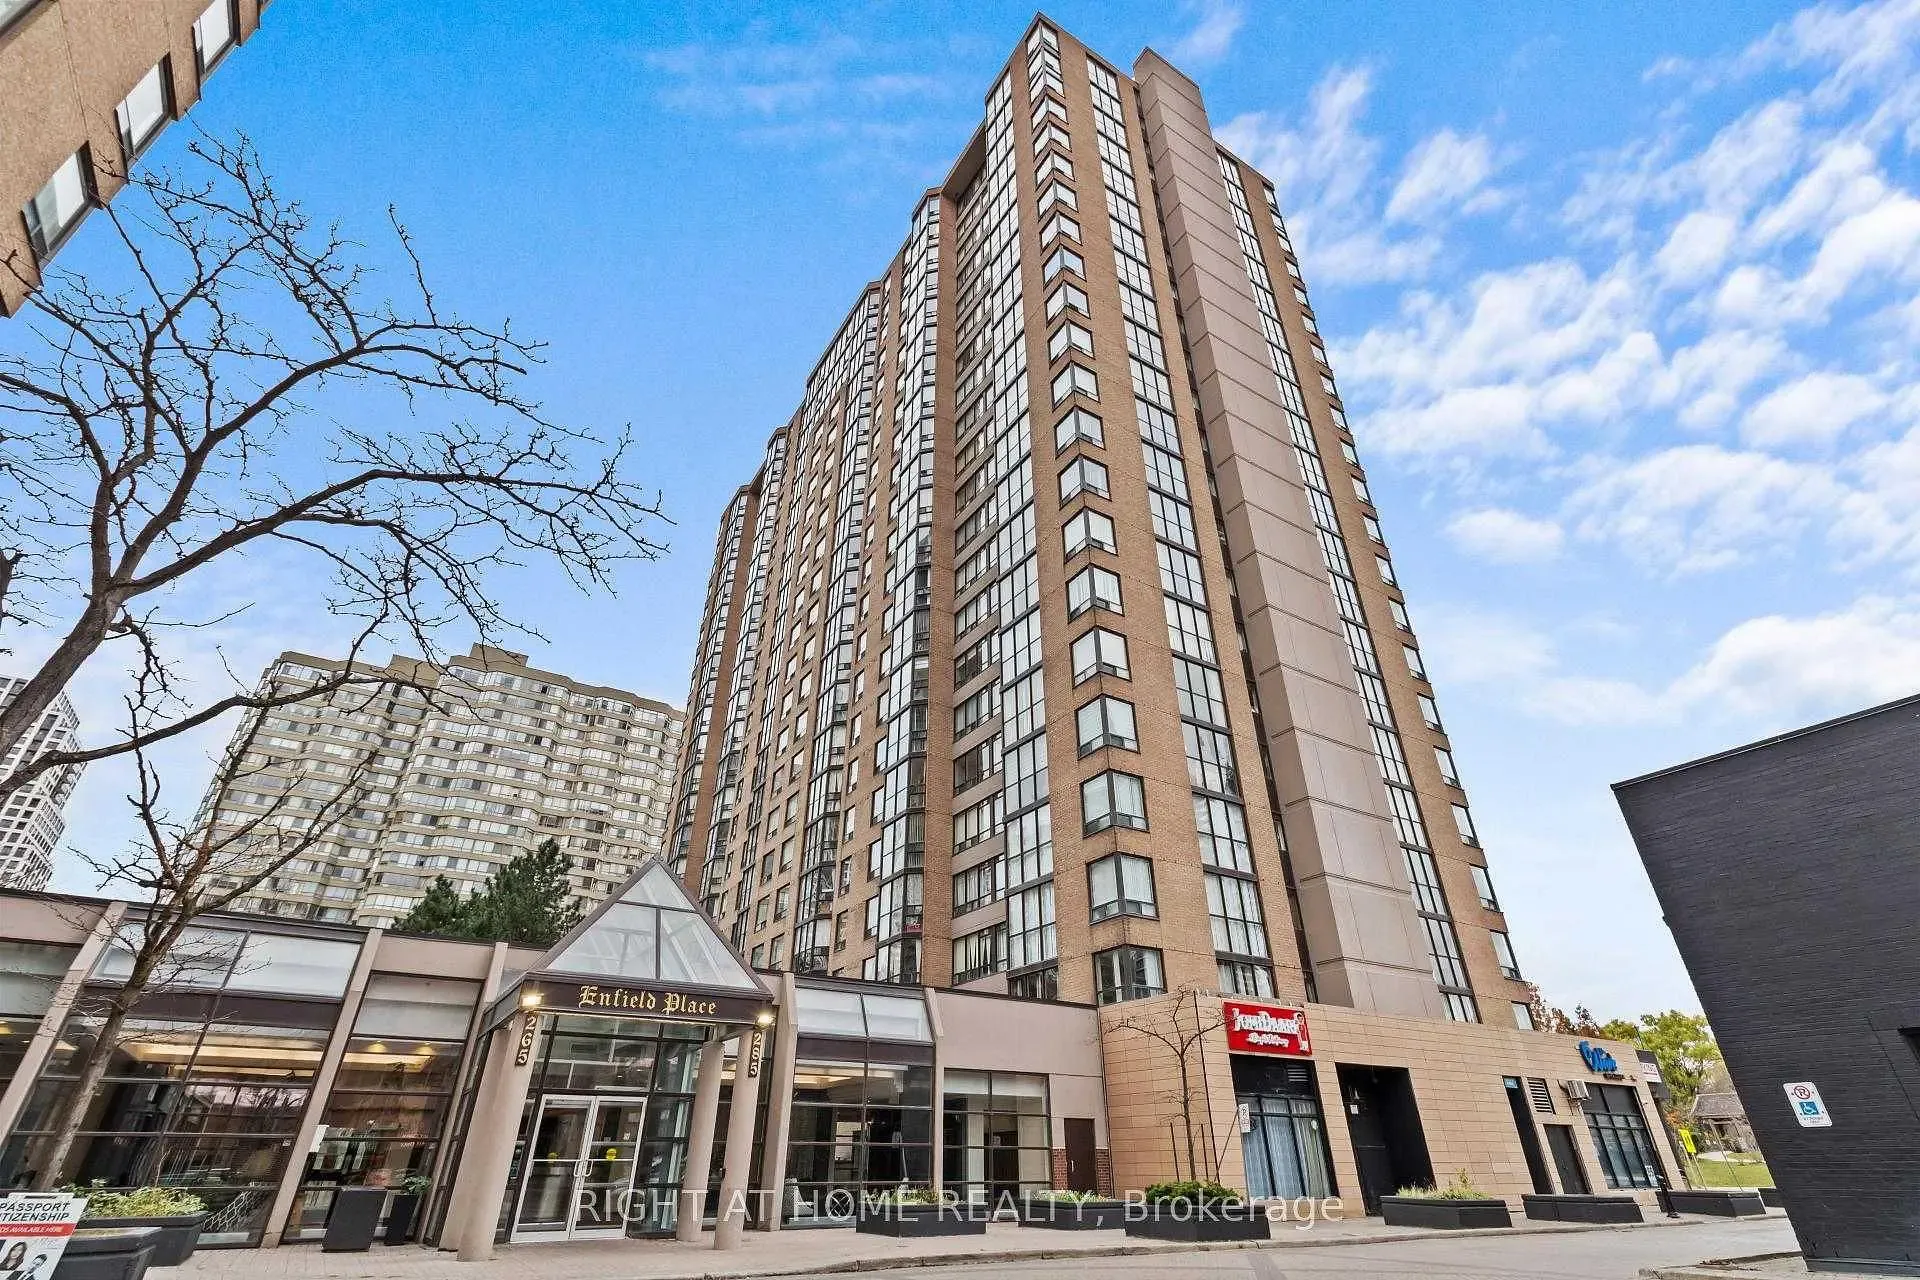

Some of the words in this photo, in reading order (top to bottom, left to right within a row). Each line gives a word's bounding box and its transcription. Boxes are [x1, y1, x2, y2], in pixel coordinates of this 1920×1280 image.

[578, 985, 656, 1010] Enfield
[661, 992, 717, 1015] Place
[518, 1015, 538, 1064] 265
[0, 1202, 70, 1212] PASSPORT
